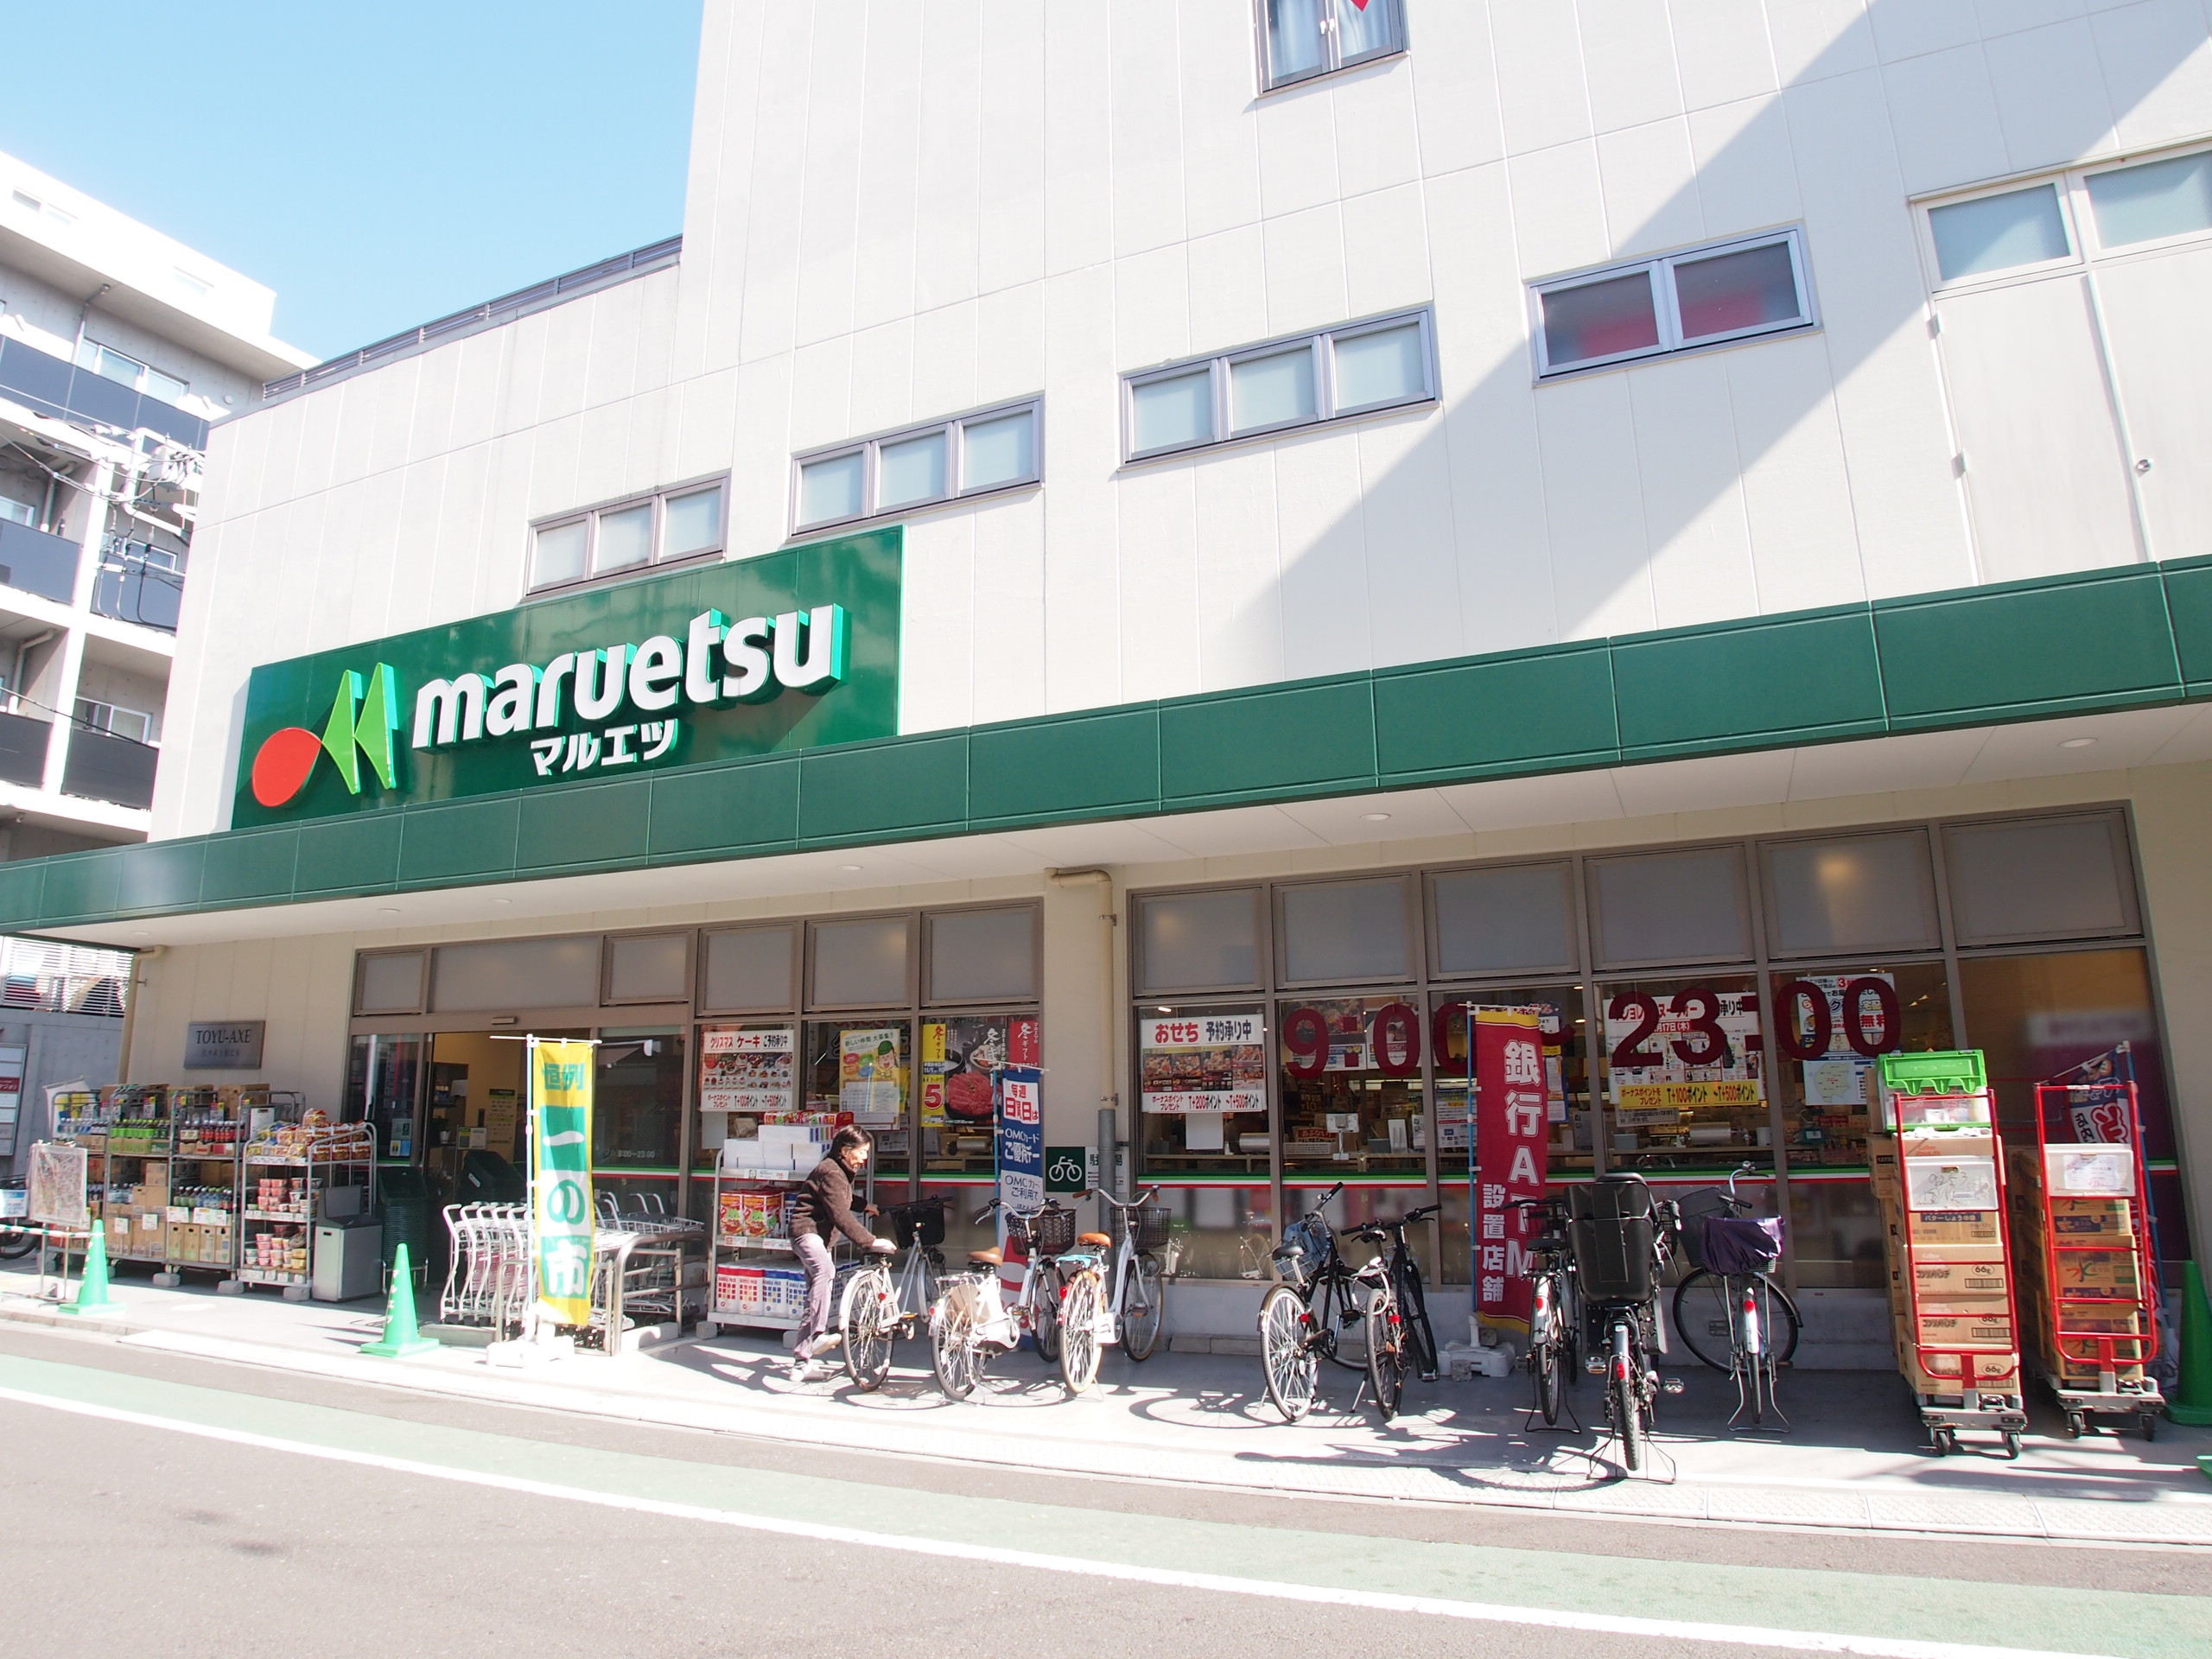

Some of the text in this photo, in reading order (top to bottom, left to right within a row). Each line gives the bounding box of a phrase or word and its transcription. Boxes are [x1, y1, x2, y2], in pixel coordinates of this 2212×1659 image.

[412, 603, 840, 750] maruetsu
[531, 719, 677, 777] マルエツ
[196, 1029, 251, 1045] TOYU-AXE
[710, 1036, 734, 1048] クリスマス
[737, 1035, 760, 1048] ケーキ
[1018, 1022, 1033, 1060] 冬ギフト
[1154, 1020, 1251, 1044] おせち 予約承り中
[924, 1084, 943, 1109] 5
[1011, 1084, 1027, 1099] 毎週
[1152, 1095, 1184, 1103] ボーナスポイント
[1005, 1128, 1039, 1144] OMCカード
[1005, 1175, 1040, 1189] OMCカー
[543, 1130, 588, 1295] 一の市
[1482, 1183, 1505, 1302] 設置店舗
